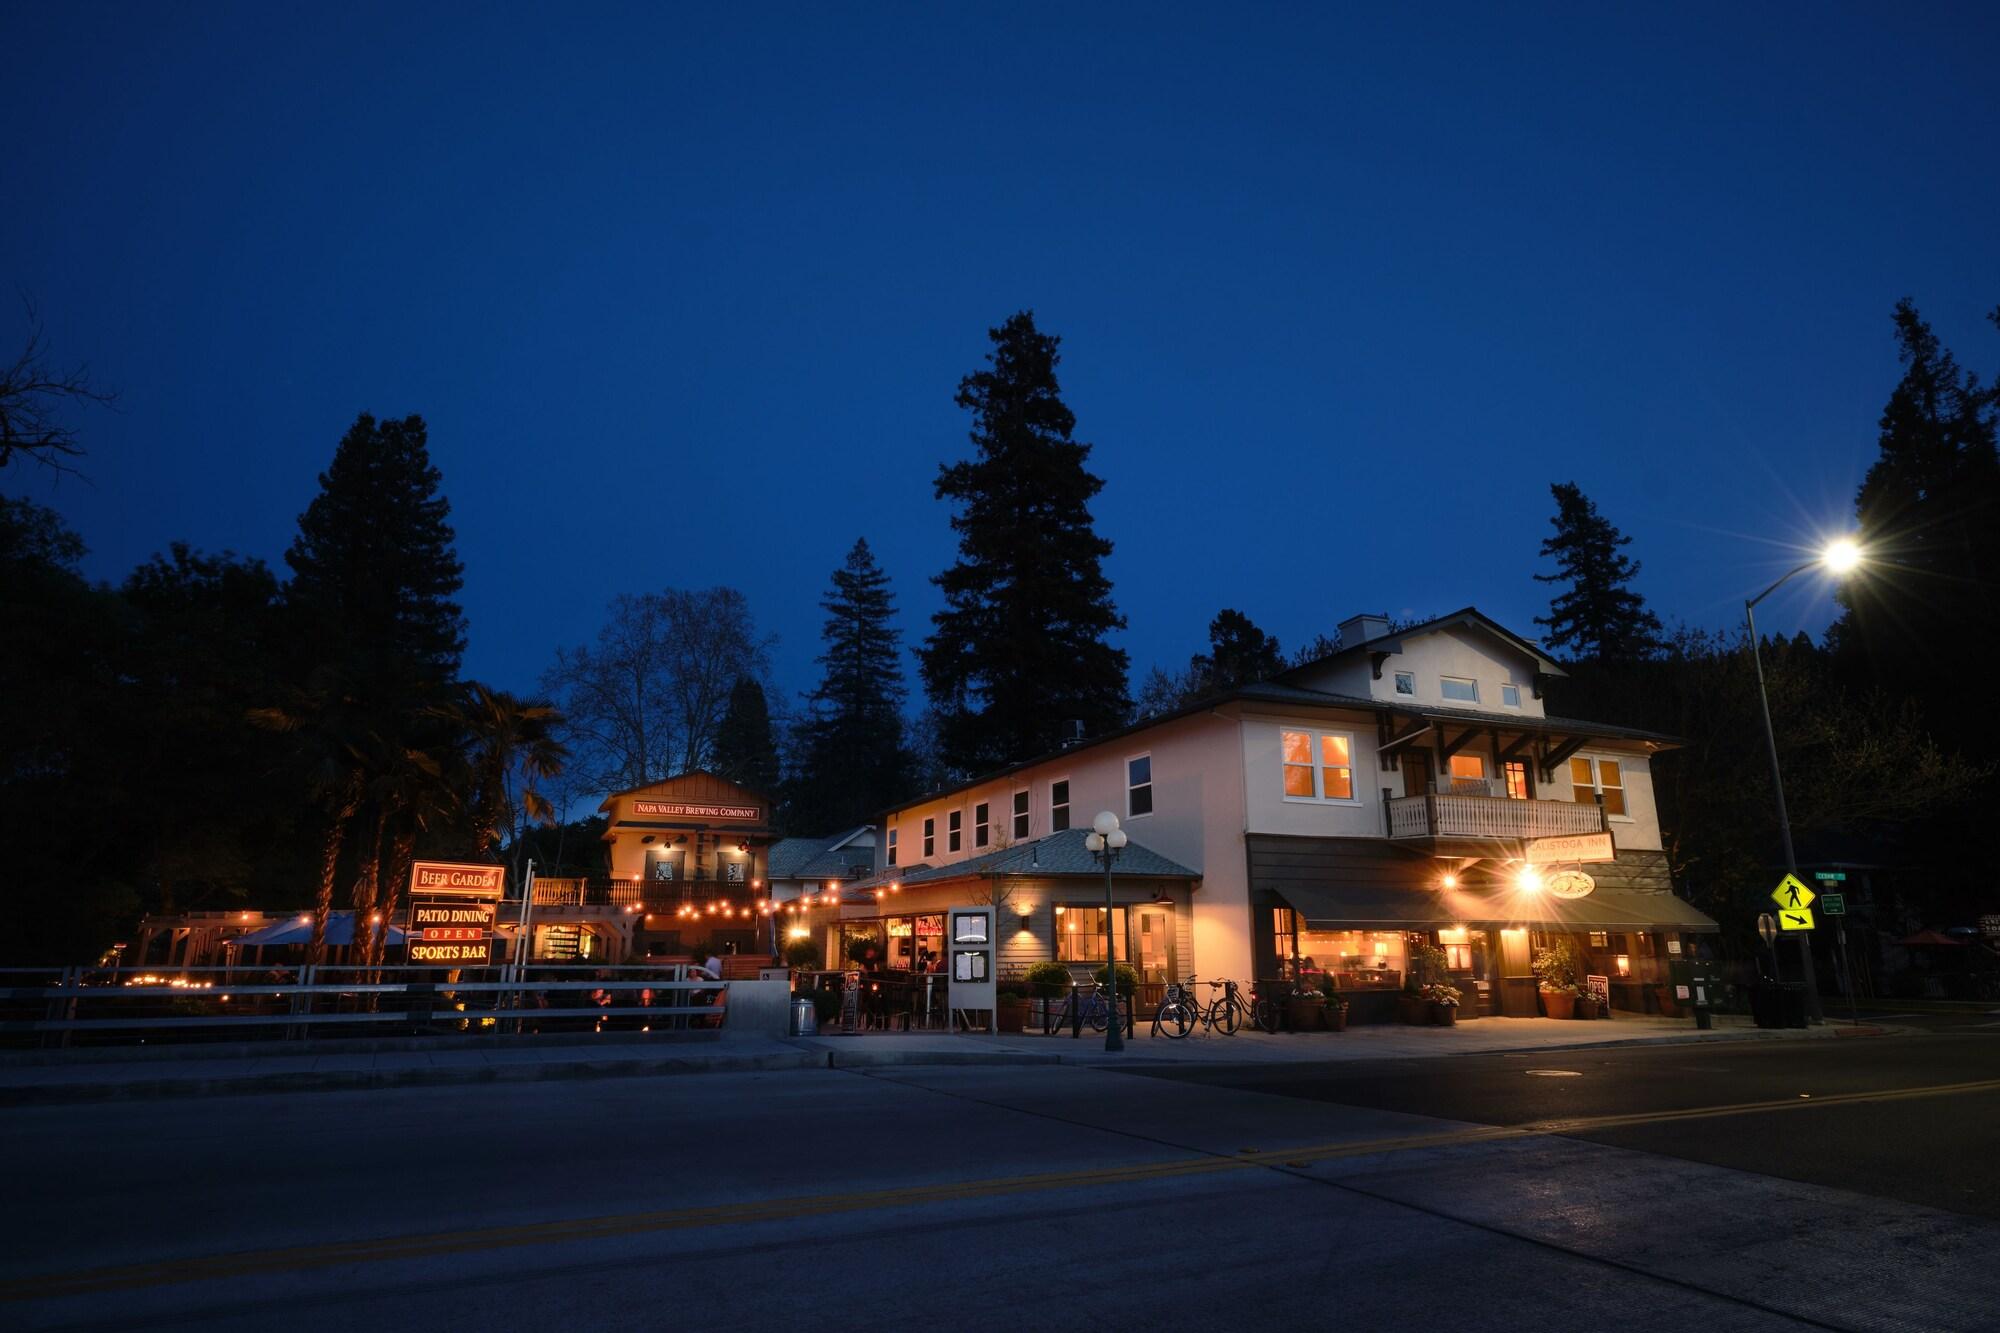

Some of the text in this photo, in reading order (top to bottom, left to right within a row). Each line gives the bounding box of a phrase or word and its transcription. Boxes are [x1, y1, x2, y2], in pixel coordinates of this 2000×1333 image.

[637, 803, 755, 818] NAPA VALLEY BREWING COMPANY
[1588, 837, 1606, 849] INN
[421, 871, 496, 887] BEER GARDEN
[417, 909, 489, 922] PATIO DINING
[430, 930, 475, 938] OPEN
[411, 945, 487, 960] SPORTS BAR
[1589, 981, 1606, 993] OPEN
